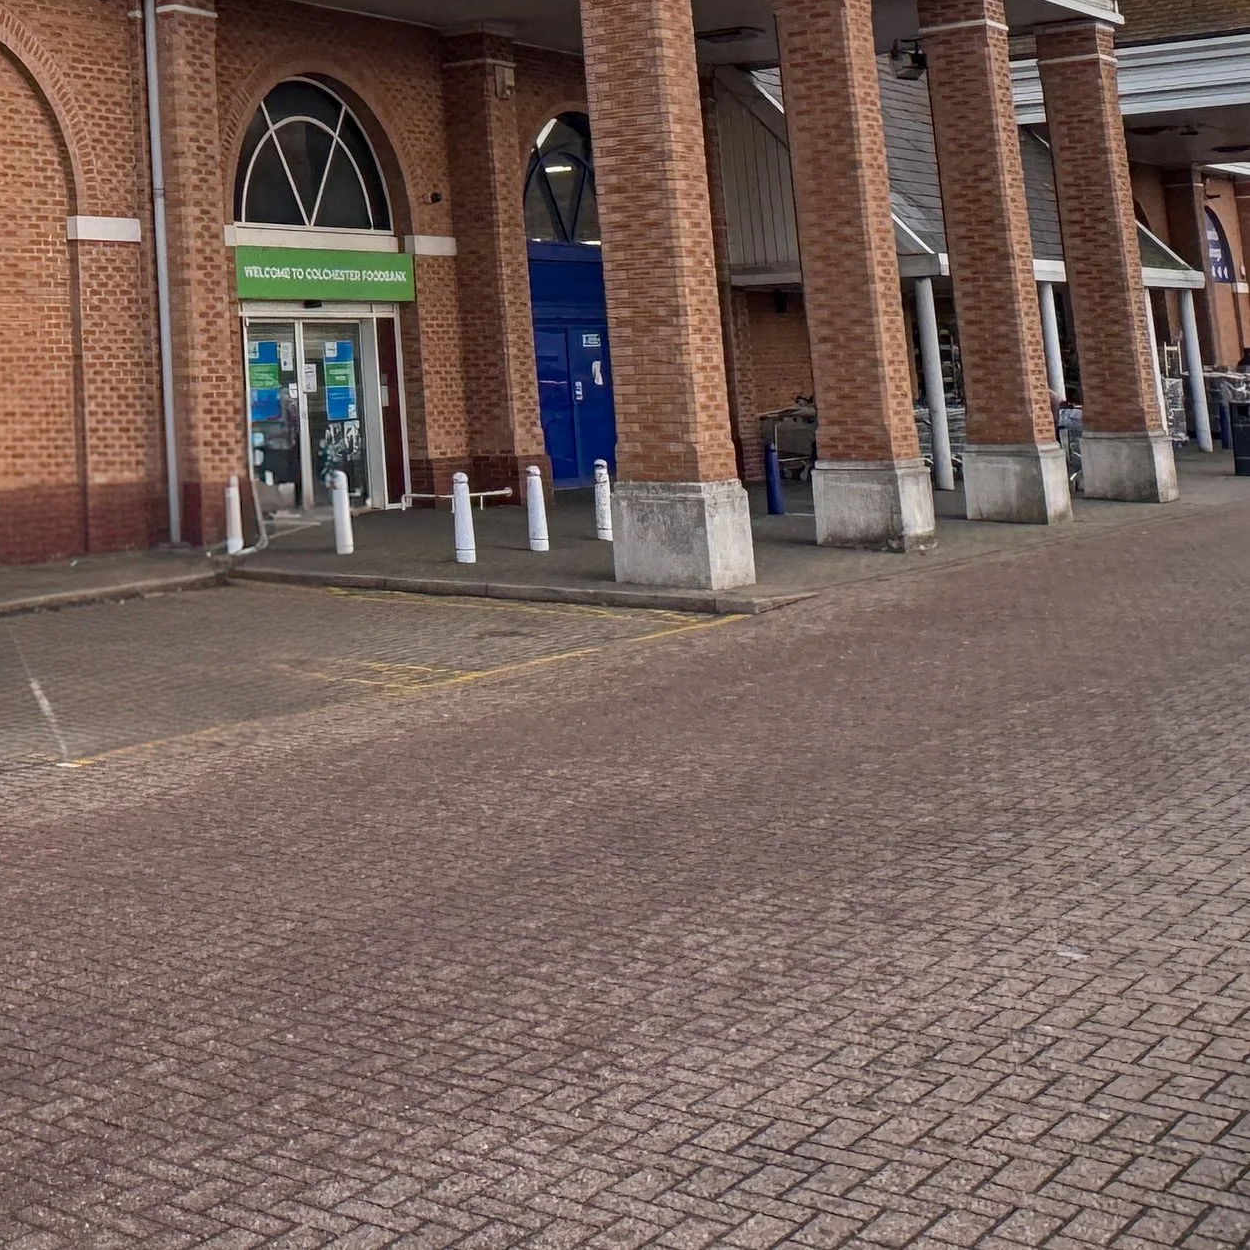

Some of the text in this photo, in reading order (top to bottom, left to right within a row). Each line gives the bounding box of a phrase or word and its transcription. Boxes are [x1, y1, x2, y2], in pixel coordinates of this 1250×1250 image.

[244, 266, 407, 282] WELCOME TO COLCHESTER FOODBANK
